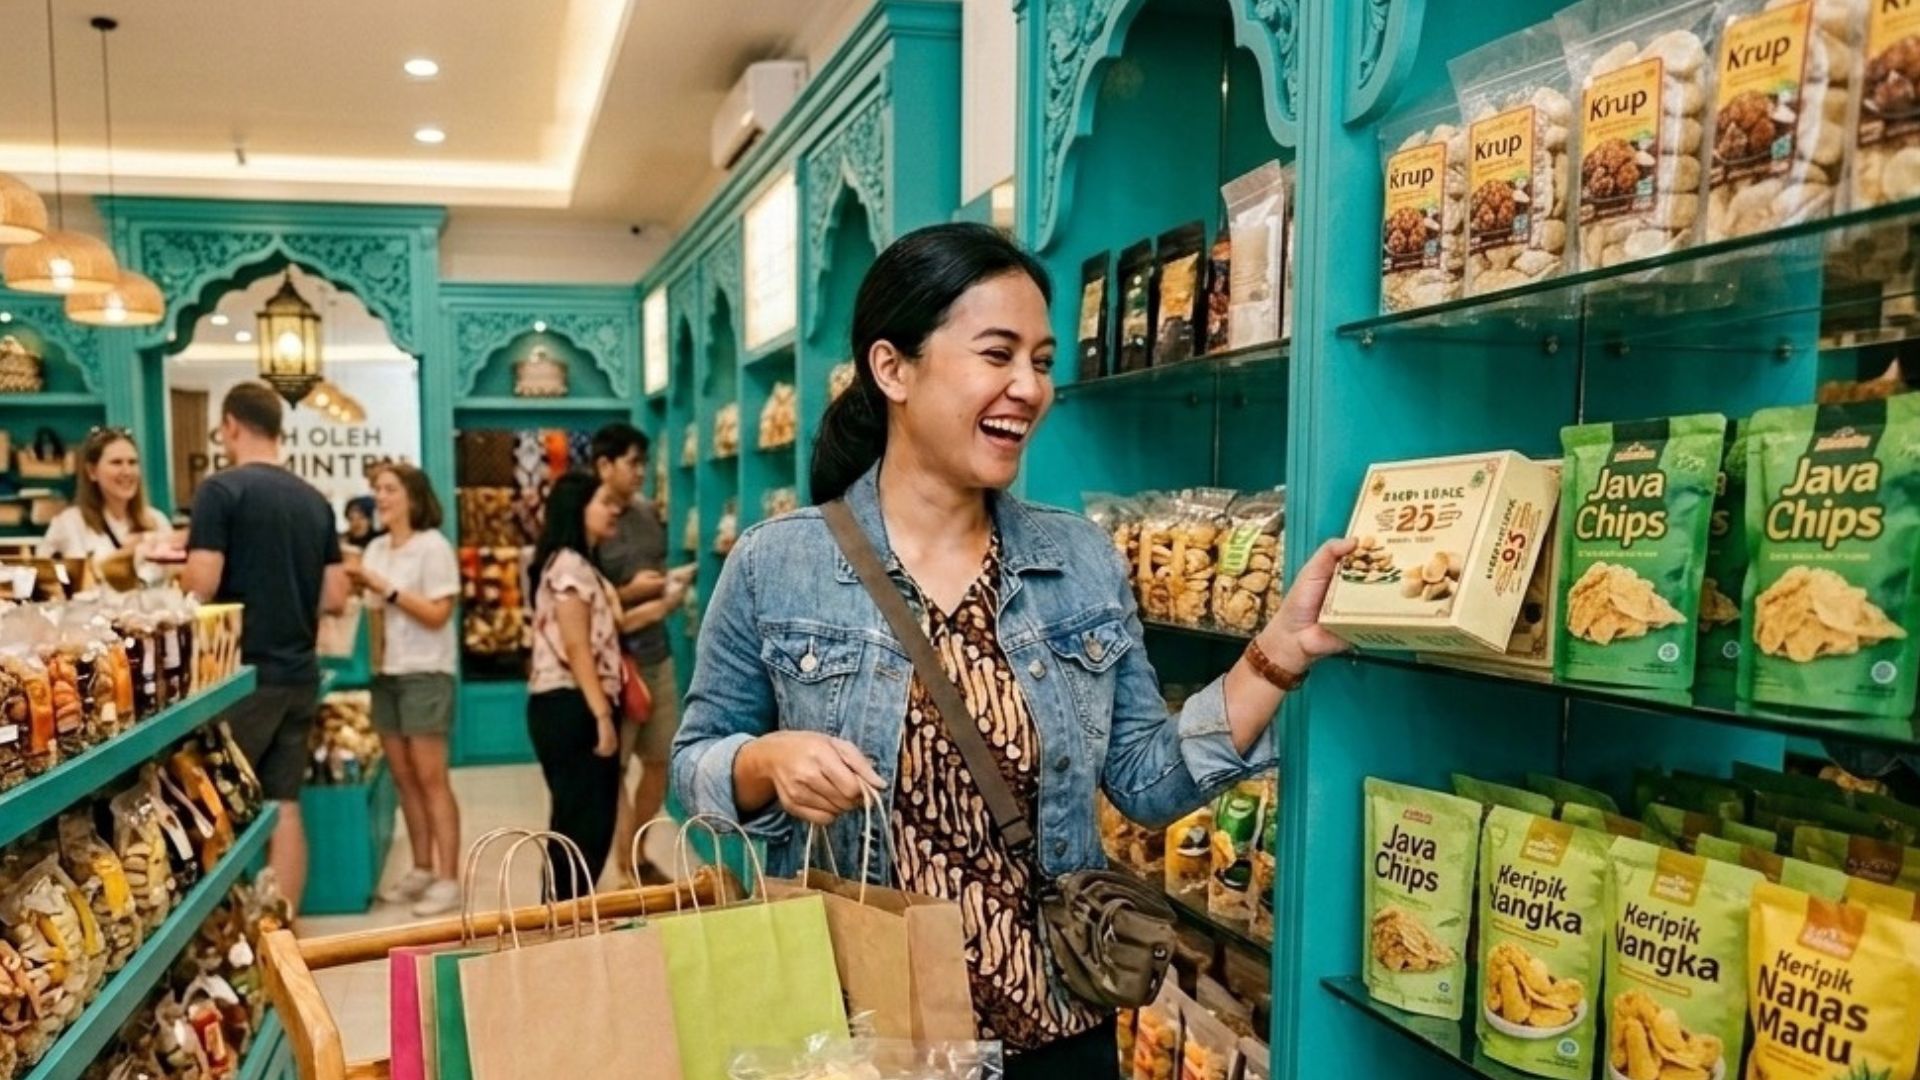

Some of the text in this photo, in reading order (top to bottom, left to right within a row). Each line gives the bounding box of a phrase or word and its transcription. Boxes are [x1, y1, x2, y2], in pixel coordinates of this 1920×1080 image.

[1727, 36, 1790, 71] Krup
[1590, 90, 1647, 122] Krup
[1475, 134, 1522, 161] Krup
[1390, 167, 1434, 189] Krup
[308, 427, 382, 446] OLEH
[1587, 467, 1665, 501] Java
[1782, 457, 1880, 496] Java
[1396, 503, 1435, 532] 25
[1576, 503, 1666, 547] Chips
[1767, 498, 1883, 548] Chips
[1382, 823, 1437, 861] Java
[1374, 851, 1439, 894] Chips
[1497, 864, 1568, 901] Keripik
[1624, 901, 1702, 945] Keripik
[1776, 949, 1853, 994] Keripik
[1757, 964, 1870, 1032] Nanas
[1757, 1002, 1853, 1066] Madu
